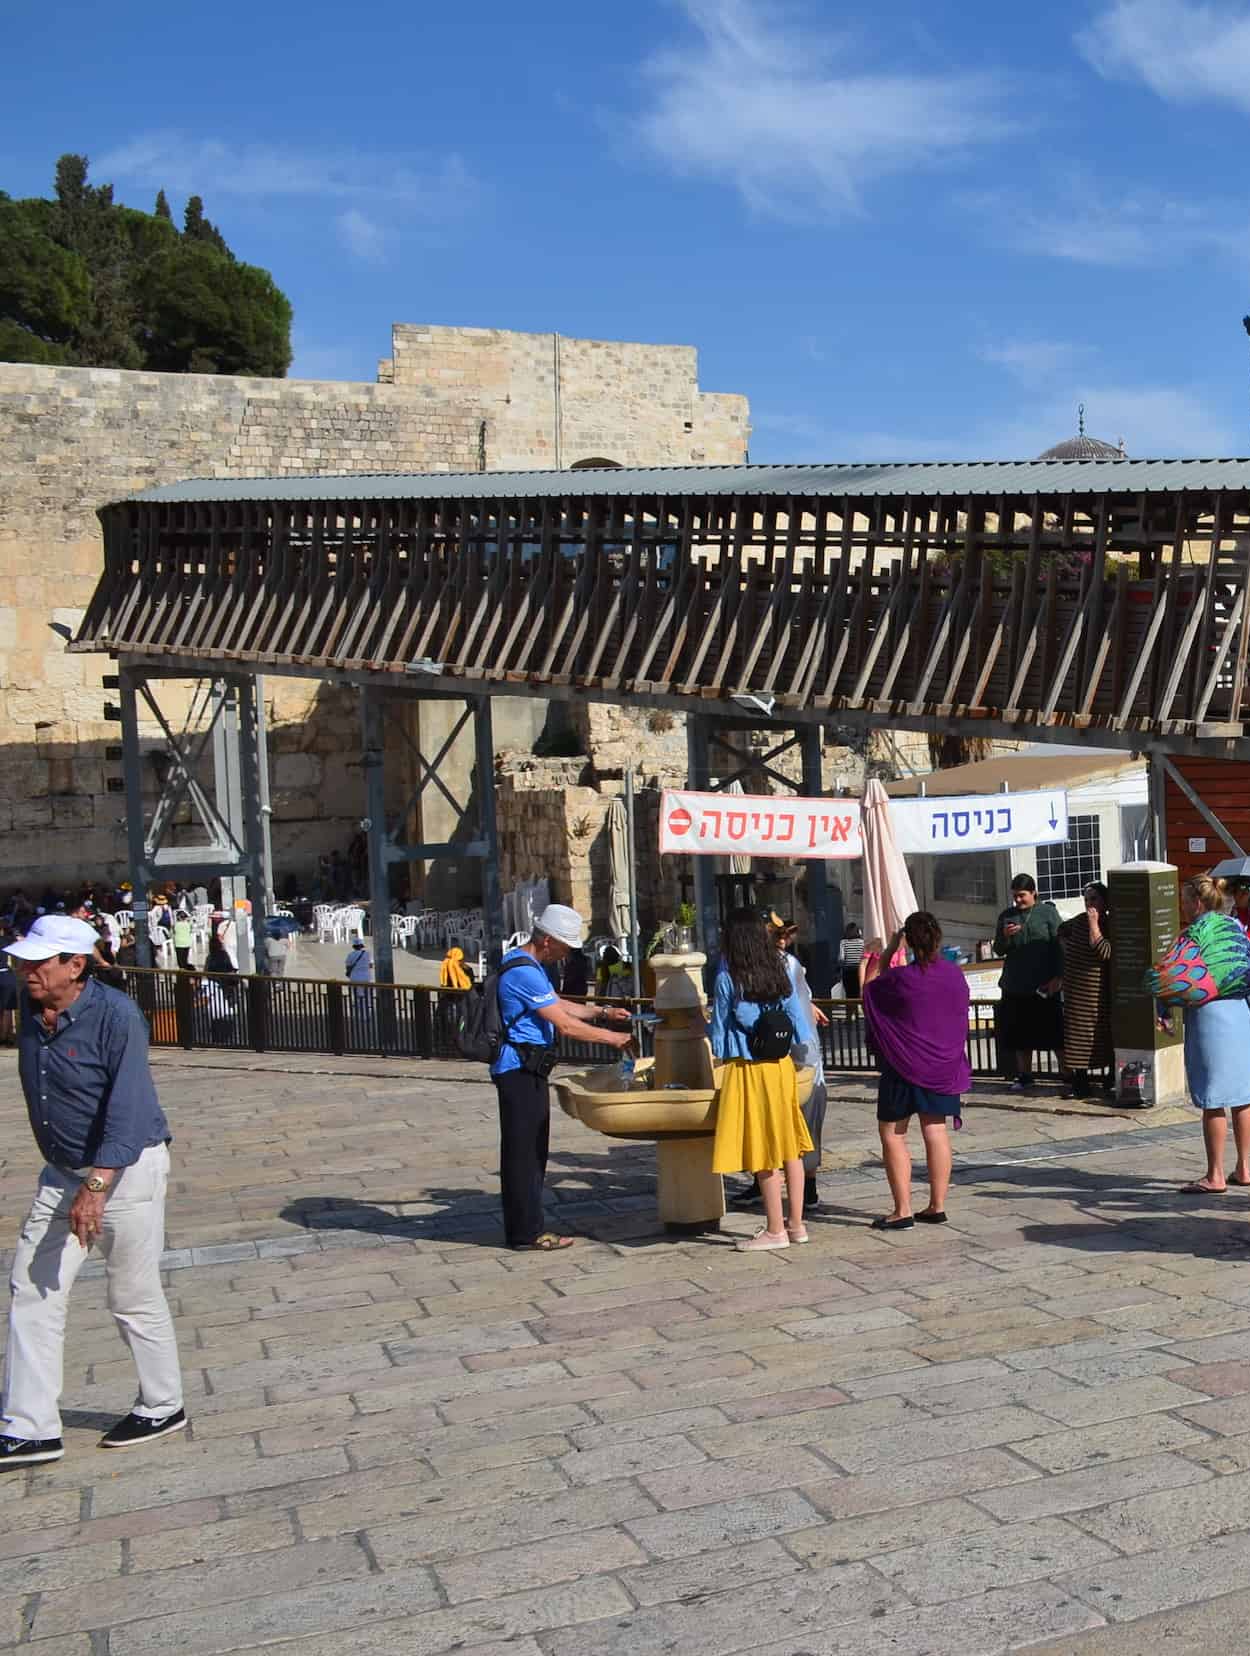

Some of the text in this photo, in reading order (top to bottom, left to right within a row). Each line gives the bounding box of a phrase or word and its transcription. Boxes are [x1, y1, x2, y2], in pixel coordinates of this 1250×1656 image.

[699, 810, 852, 848] אין כניסה
[931, 807, 1012, 838] כניסה
